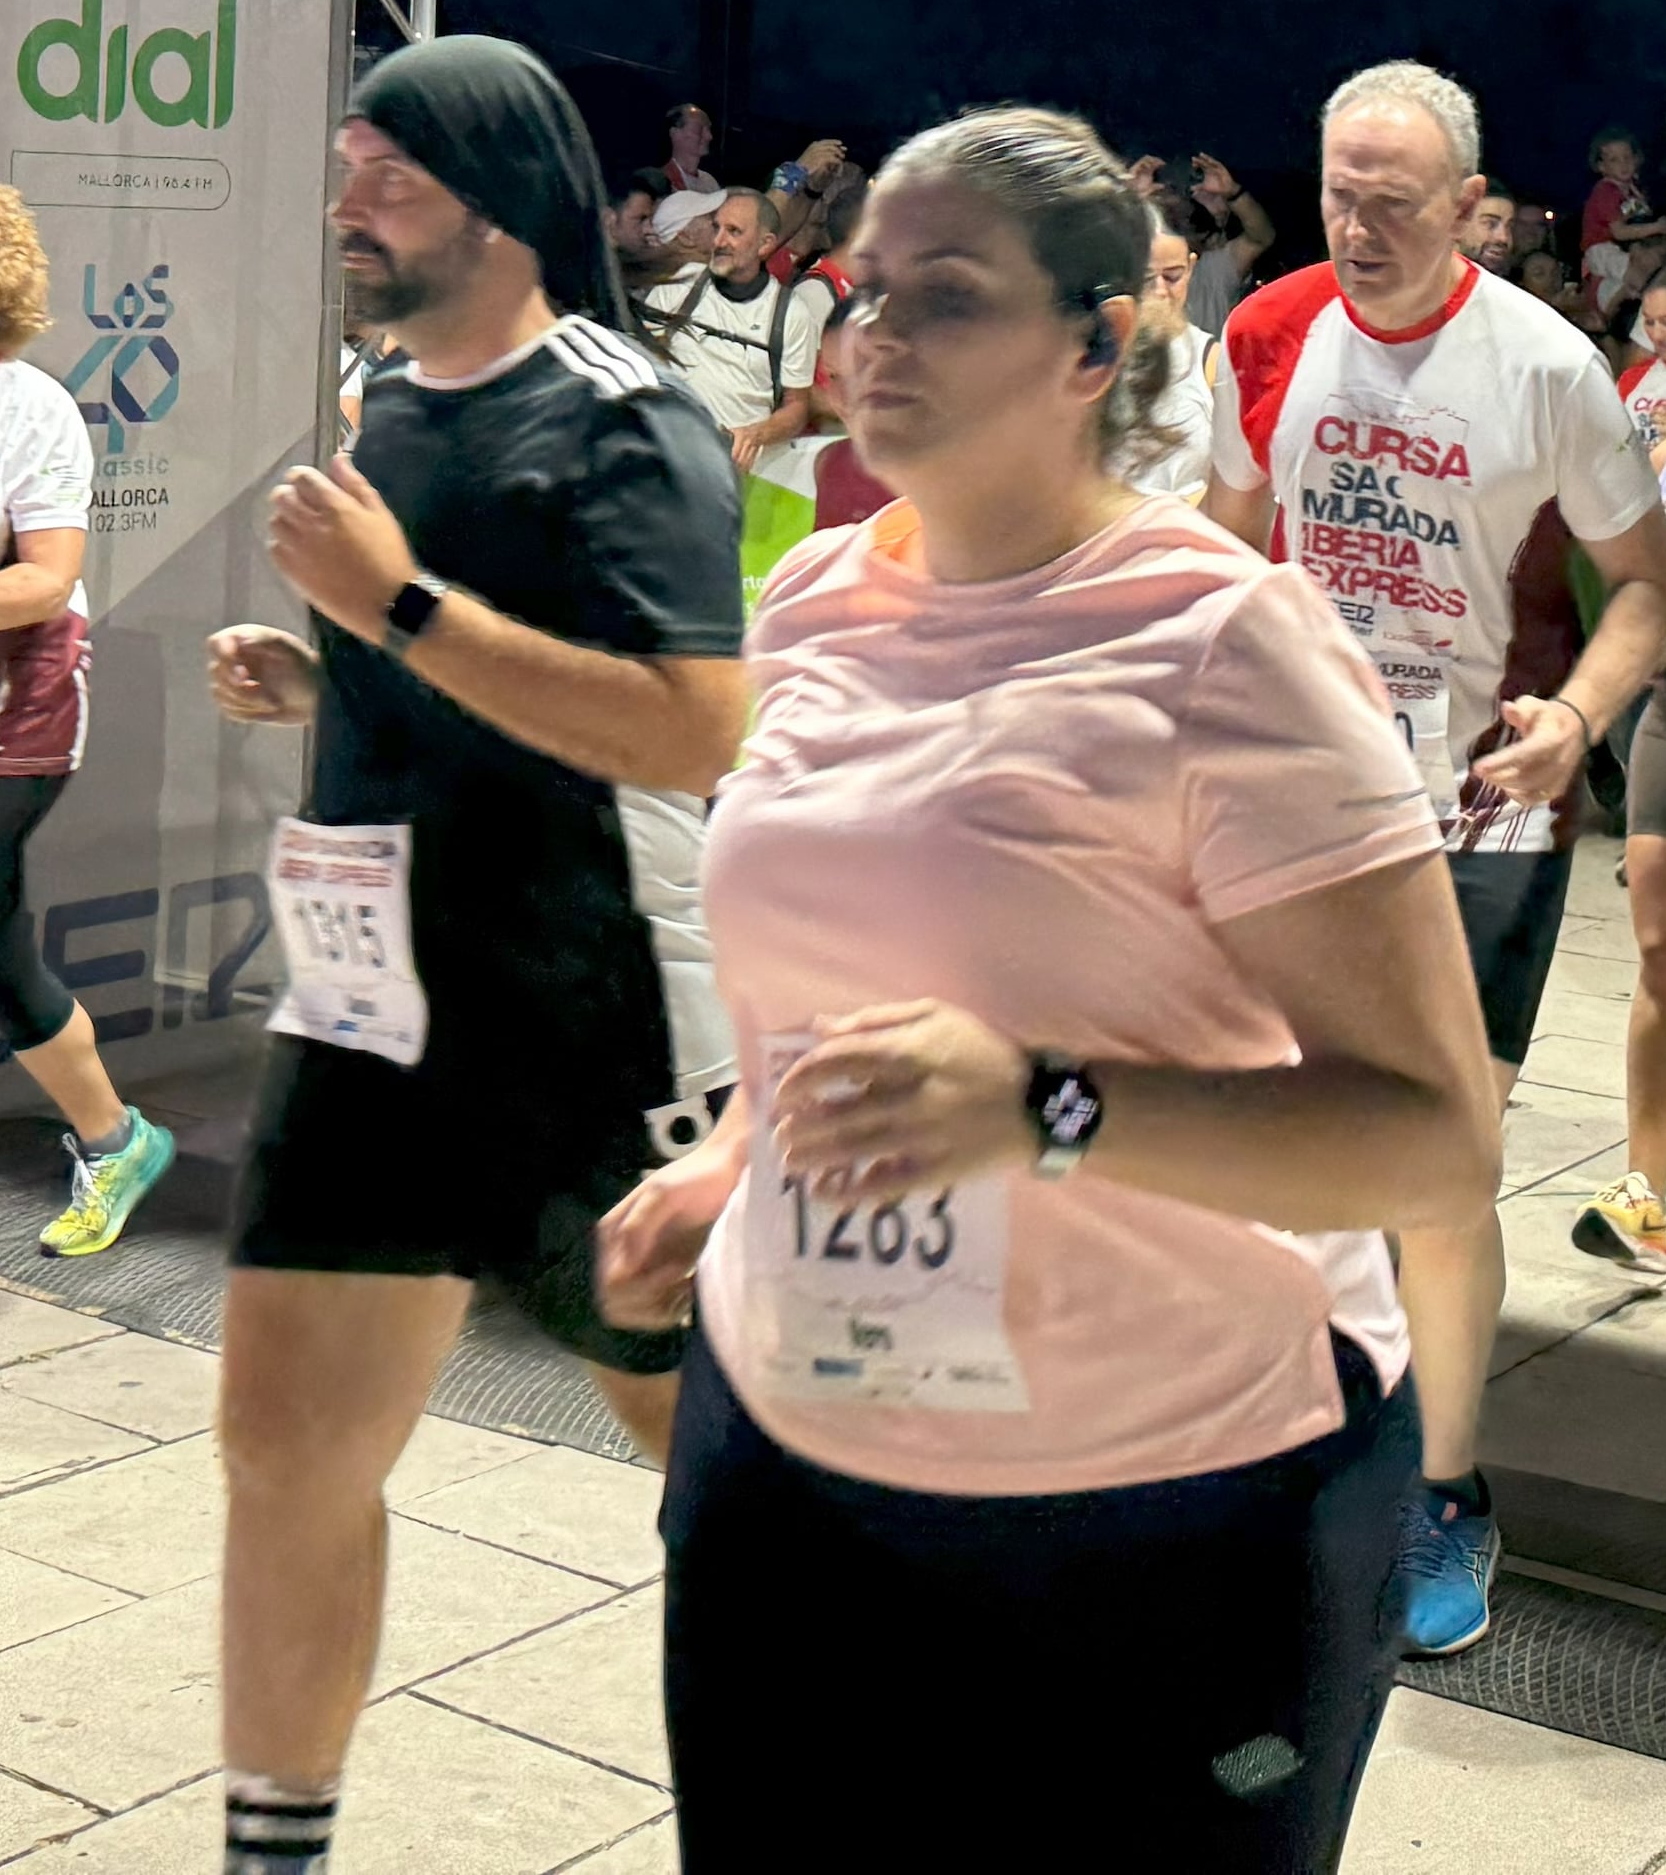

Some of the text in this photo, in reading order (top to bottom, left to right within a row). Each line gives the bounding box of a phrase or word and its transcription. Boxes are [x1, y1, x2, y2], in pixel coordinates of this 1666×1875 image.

[78, 173, 151, 189] MALLORCA
[95, 452, 170, 477] lassic
[1314, 415, 1473, 486] CURSA
[1330, 461, 1379, 496] SA
[89, 487, 170, 509] ALLORCA
[1302, 488, 1461, 551] MURADA
[1301, 520, 1422, 572] IBERIA
[1301, 558, 1468, 619] EXPRESS
[1333, 599, 1375, 625] ER
[1380, 662, 1443, 681] URADA
